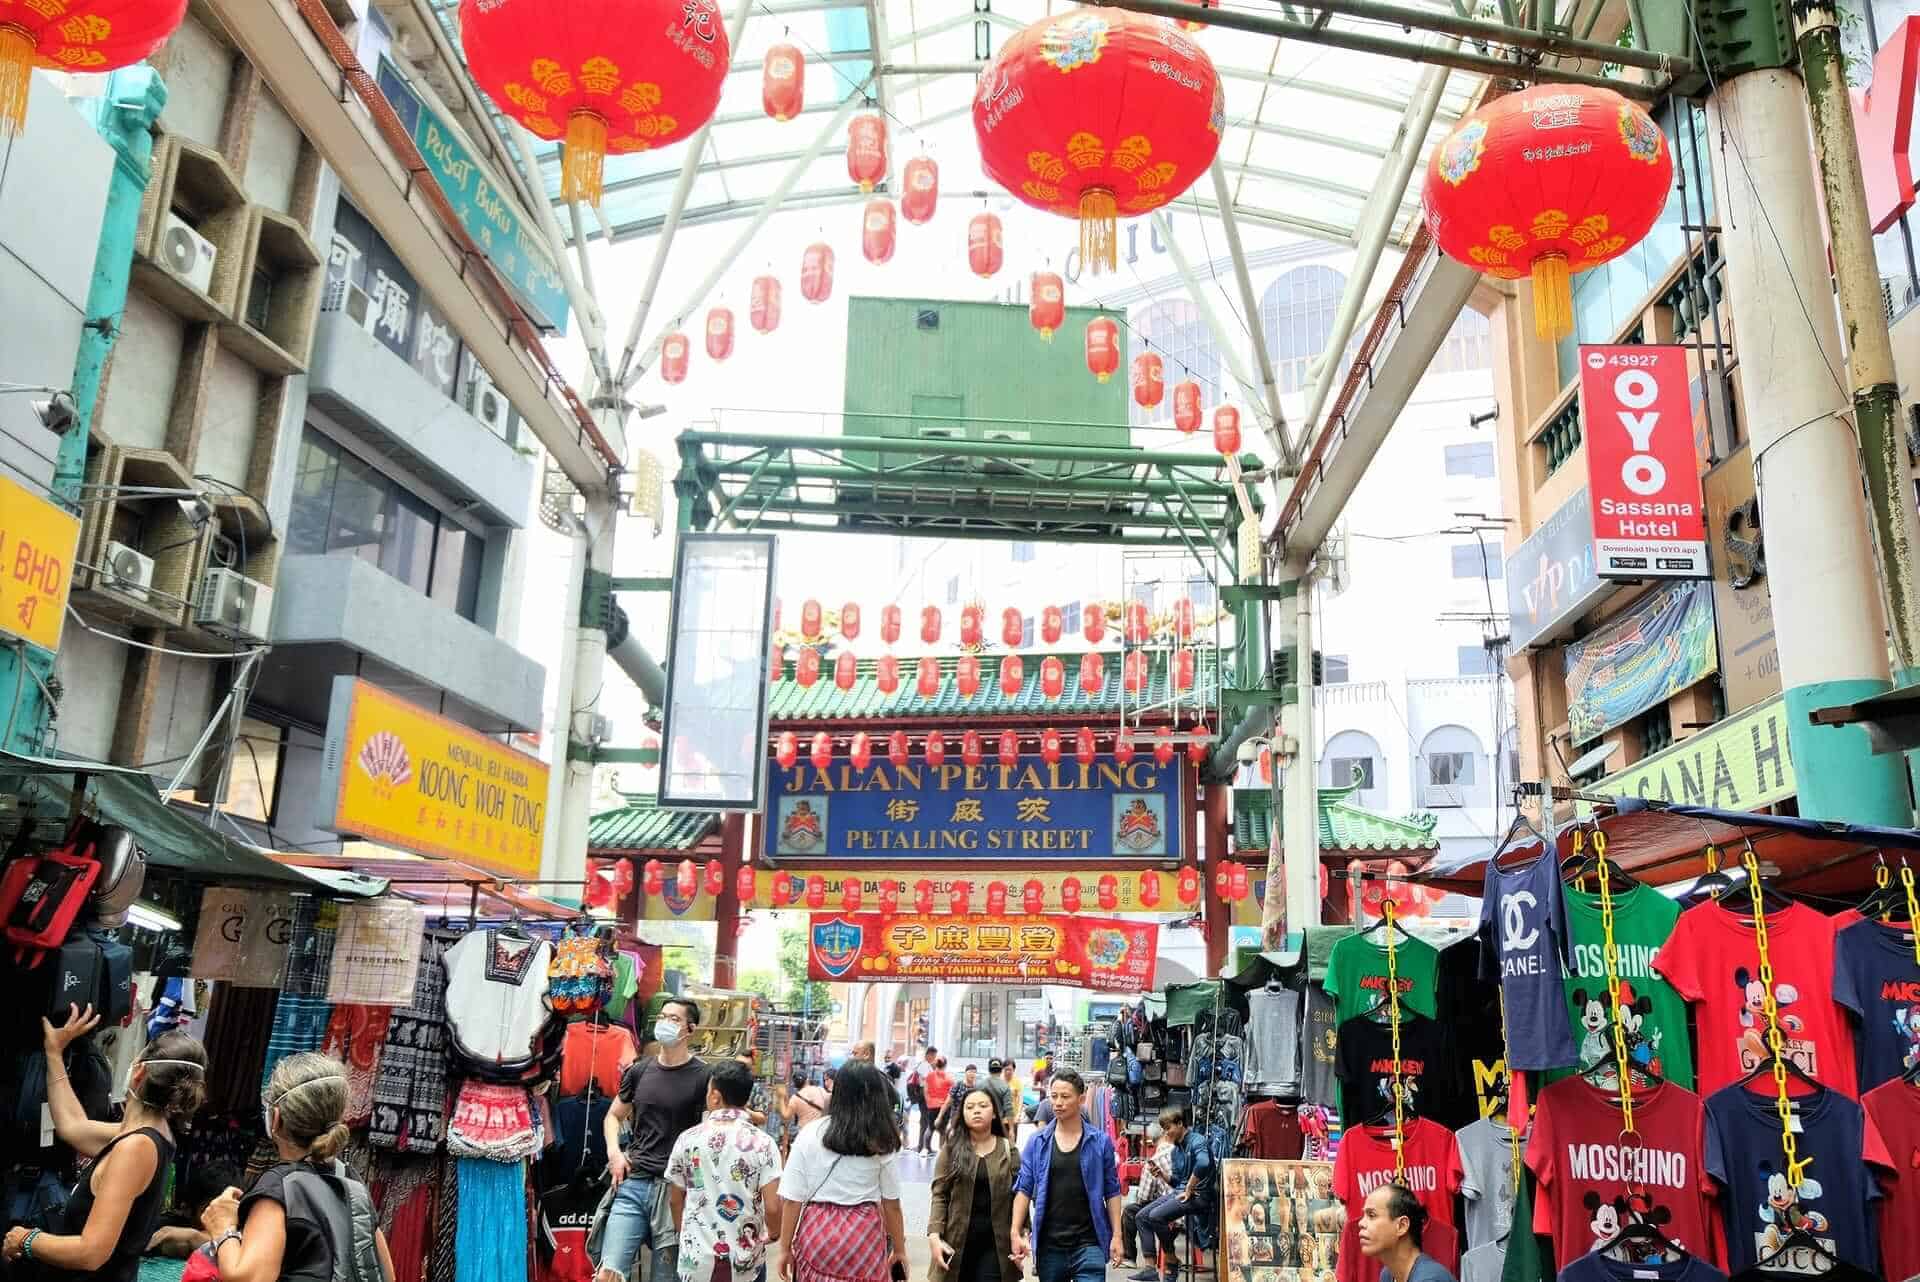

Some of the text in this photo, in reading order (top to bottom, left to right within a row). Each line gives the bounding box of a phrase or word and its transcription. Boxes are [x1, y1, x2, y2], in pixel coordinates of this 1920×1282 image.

[1607, 354, 1658, 367] 43927
[1614, 369, 1666, 496] OYO
[1601, 498, 1693, 517] Sassana
[1619, 519, 1678, 537] Hotel
[1602, 544, 1644, 553] Download
[1661, 545, 1680, 553] OYO
[14, 540, 61, 601] BHD.
[786, 760, 1158, 792] JALAN PETALING
[419, 758, 468, 809] KOONG
[475, 779, 506, 821] WOH
[512, 793, 542, 834] TONG
[846, 829, 1094, 850] PETALING STREET
[897, 965, 1048, 976] SELAMAT TAHUN BARU INA
[1568, 1143, 1687, 1189] MOSCHINO
